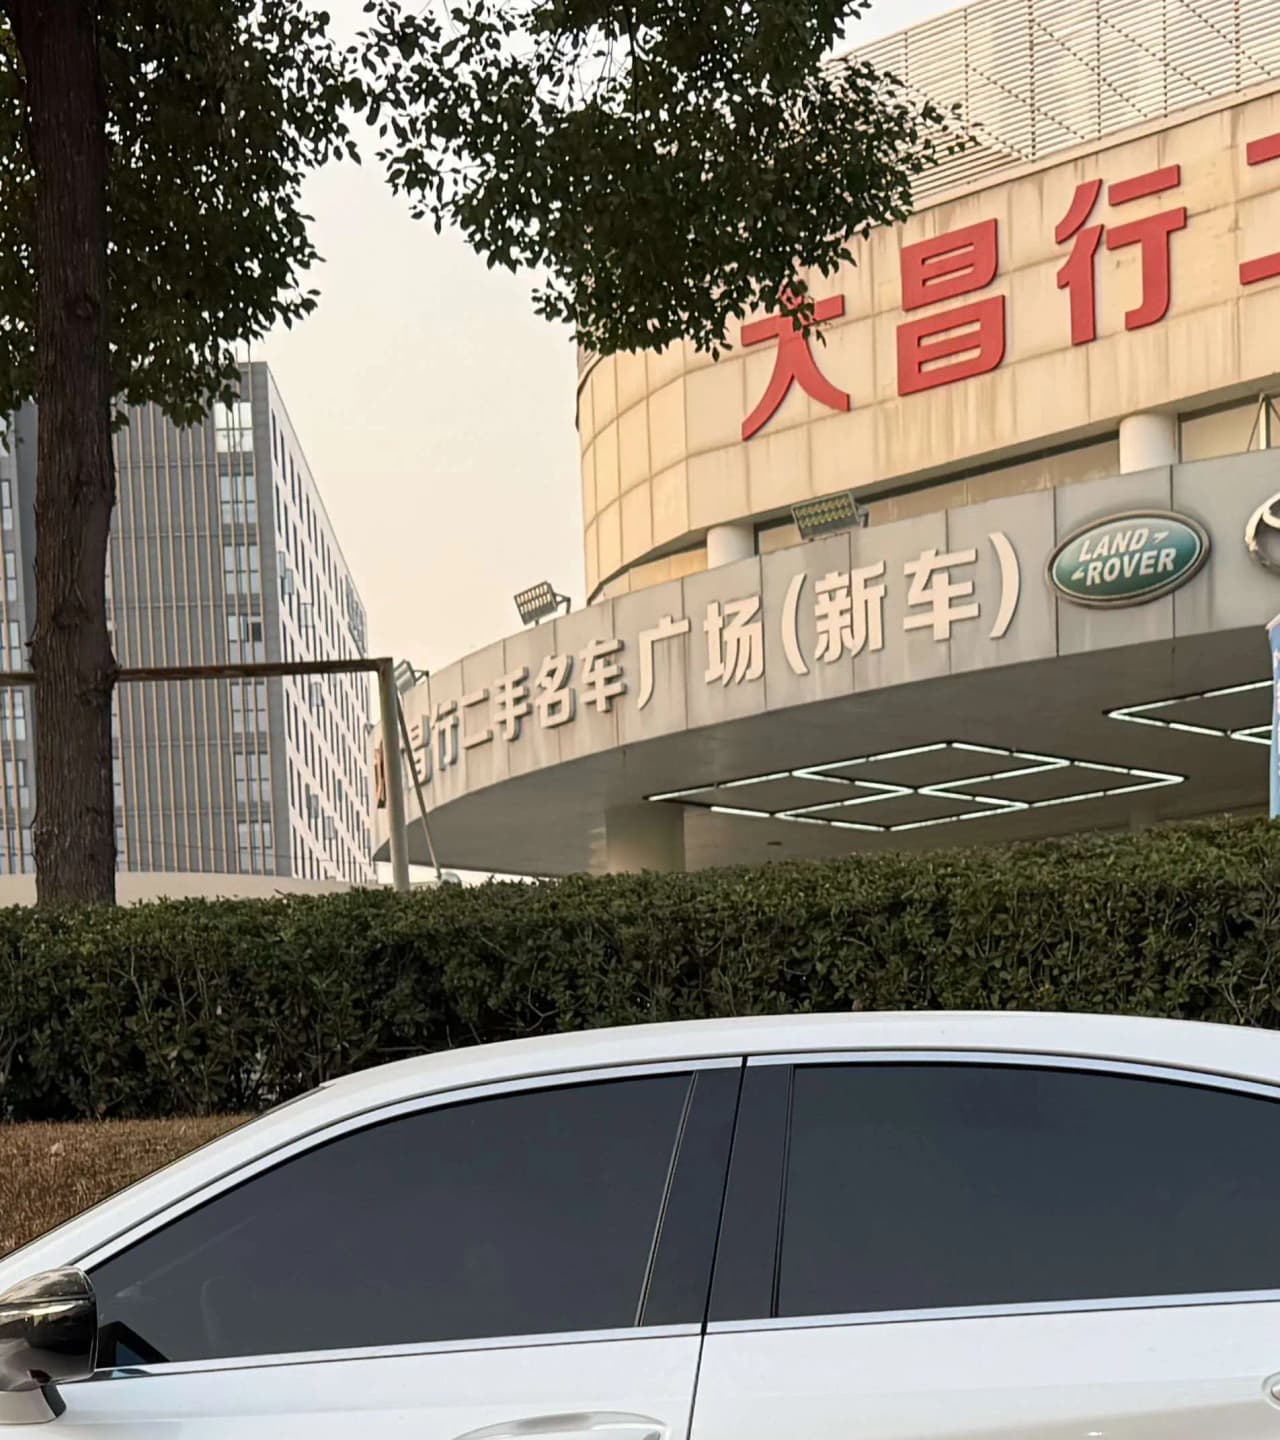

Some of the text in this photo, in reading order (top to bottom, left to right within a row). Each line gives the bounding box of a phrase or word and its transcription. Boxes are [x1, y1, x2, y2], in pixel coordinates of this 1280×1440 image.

[1078, 527, 1150, 563] LAND
[1085, 547, 1178, 587] ROVER
[400, 531, 1020, 787] 昌行二手名车广场（新车）
